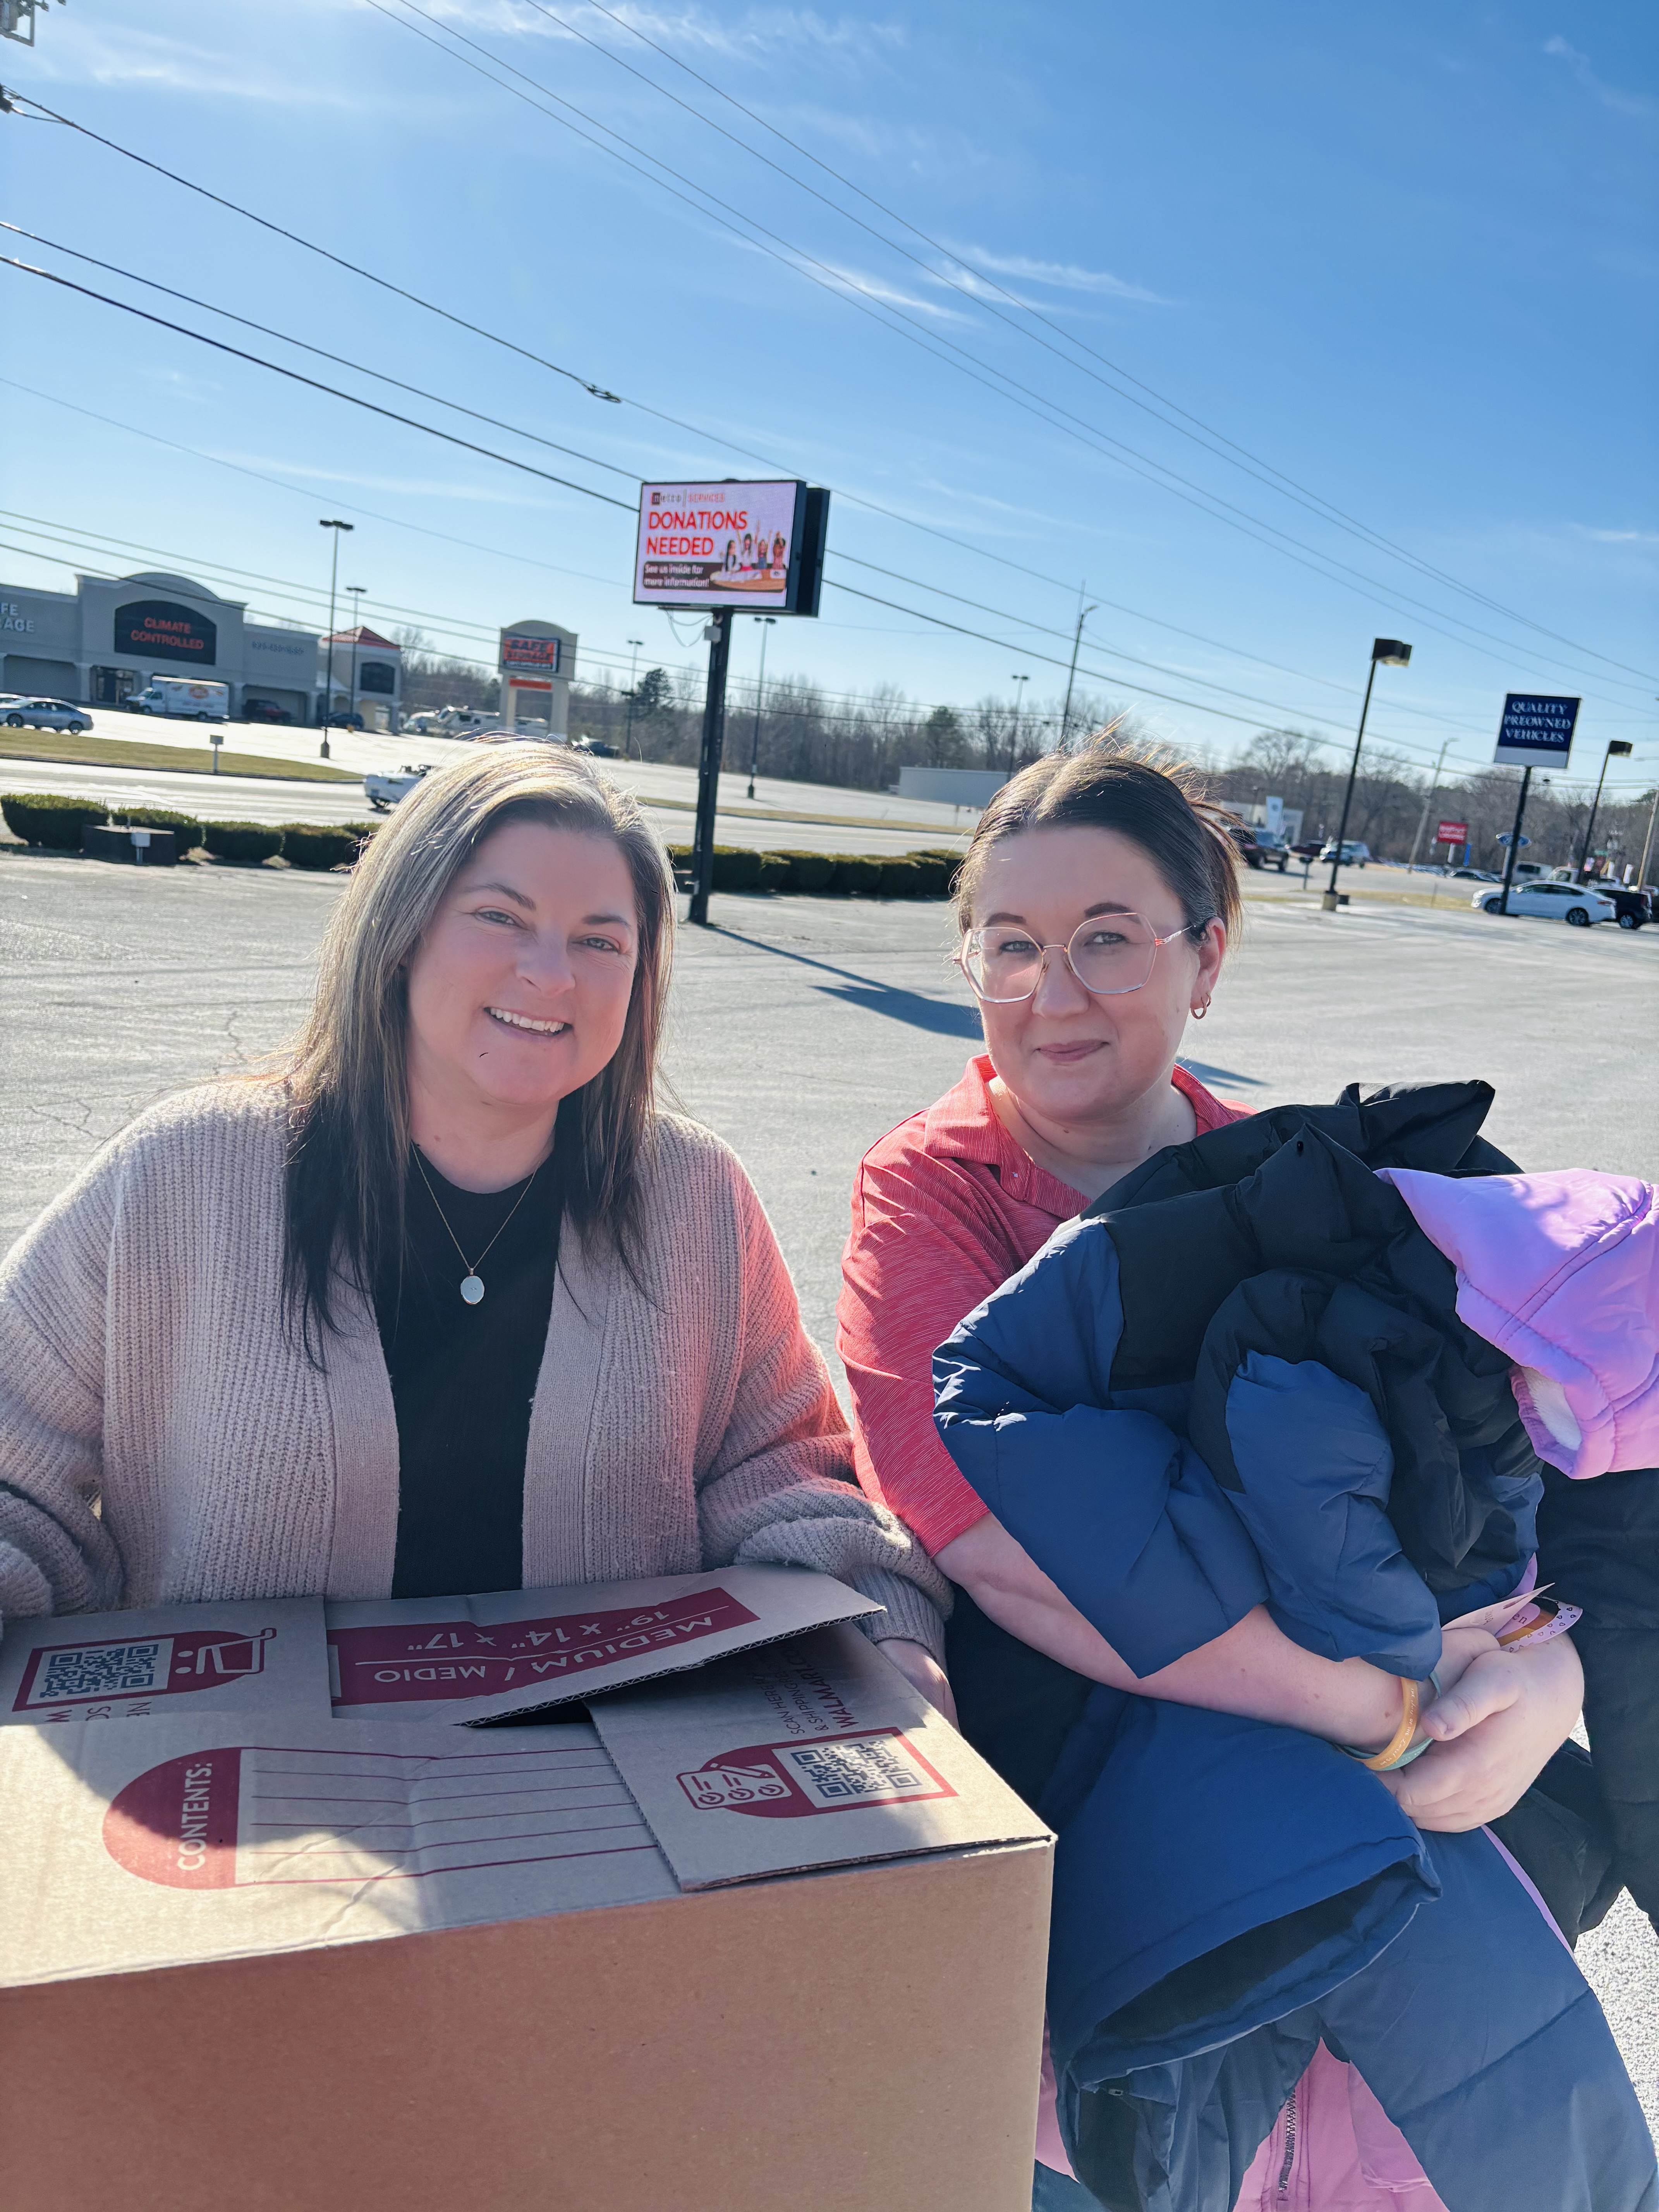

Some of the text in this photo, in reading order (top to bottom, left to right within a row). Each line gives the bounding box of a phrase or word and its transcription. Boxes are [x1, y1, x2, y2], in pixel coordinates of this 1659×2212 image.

[648, 510, 749, 530] DONATIONS
[646, 536, 714, 556] NEEDED
[0, 617, 35, 632] AGE
[144, 617, 191, 634] CLIMATE
[131, 629, 204, 650] CONTROLLED
[1512, 701, 1568, 715] QUALITY
[1504, 714, 1571, 729] PREOWNED
[1505, 728, 1565, 743] VEHICLES
[531, 1616, 712, 1673] MEDIUM
[374, 1666, 486, 1683] MEDIO
[760, 1684, 787, 1710] HERE
[783, 1682, 823, 1724] SHIPPING
[776, 1710, 805, 1735] SCAN
[177, 1763, 212, 1871] CONTENTS:
